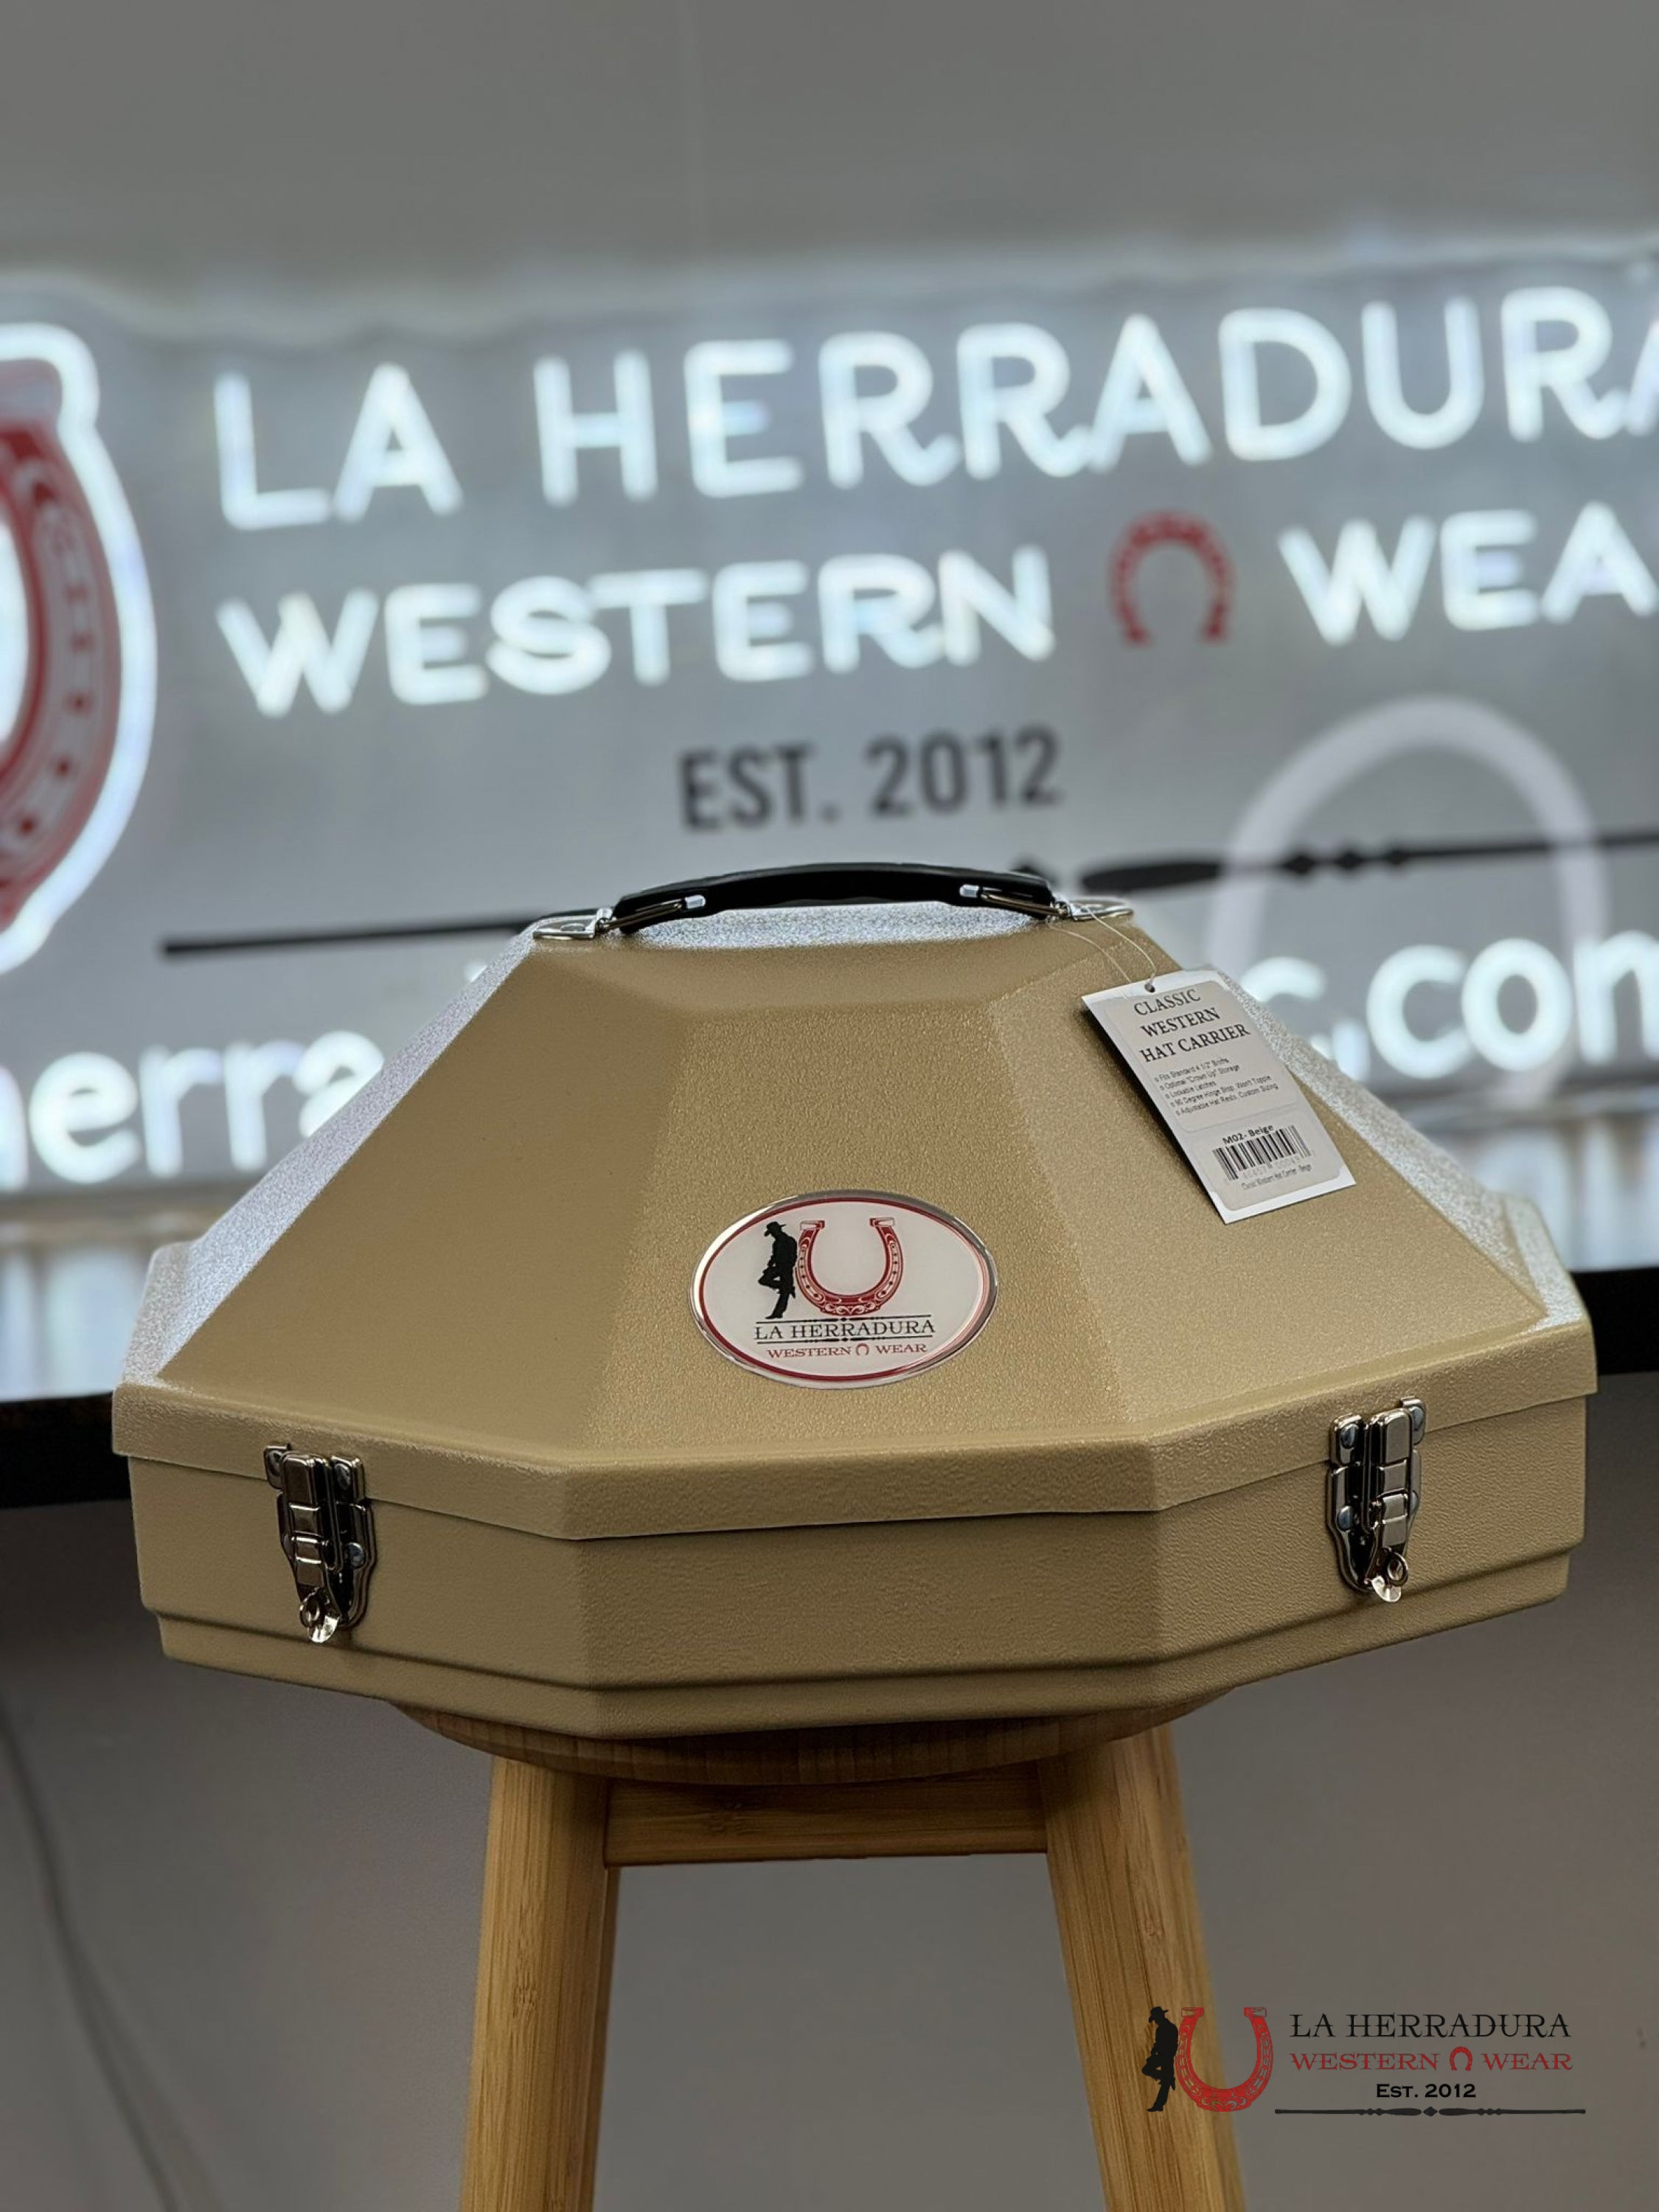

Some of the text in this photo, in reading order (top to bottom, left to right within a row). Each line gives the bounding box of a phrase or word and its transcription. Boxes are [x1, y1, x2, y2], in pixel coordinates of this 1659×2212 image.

[213, 286, 1659, 531] LA HERRADUR
[217, 545, 1056, 717] WESTERN
[677, 724, 1063, 834] EST. 2012
[1134, 989, 1200, 1015] CLASSIC
[1141, 1007, 1220, 1037] WESTERN
[1139, 1023, 1251, 1062] HAT CARRIER
[1248, 1125, 1274, 1136] Beige
[755, 1320, 936, 1340] LA HERRADURA
[767, 1343, 927, 1358] WESTERN WEAR
